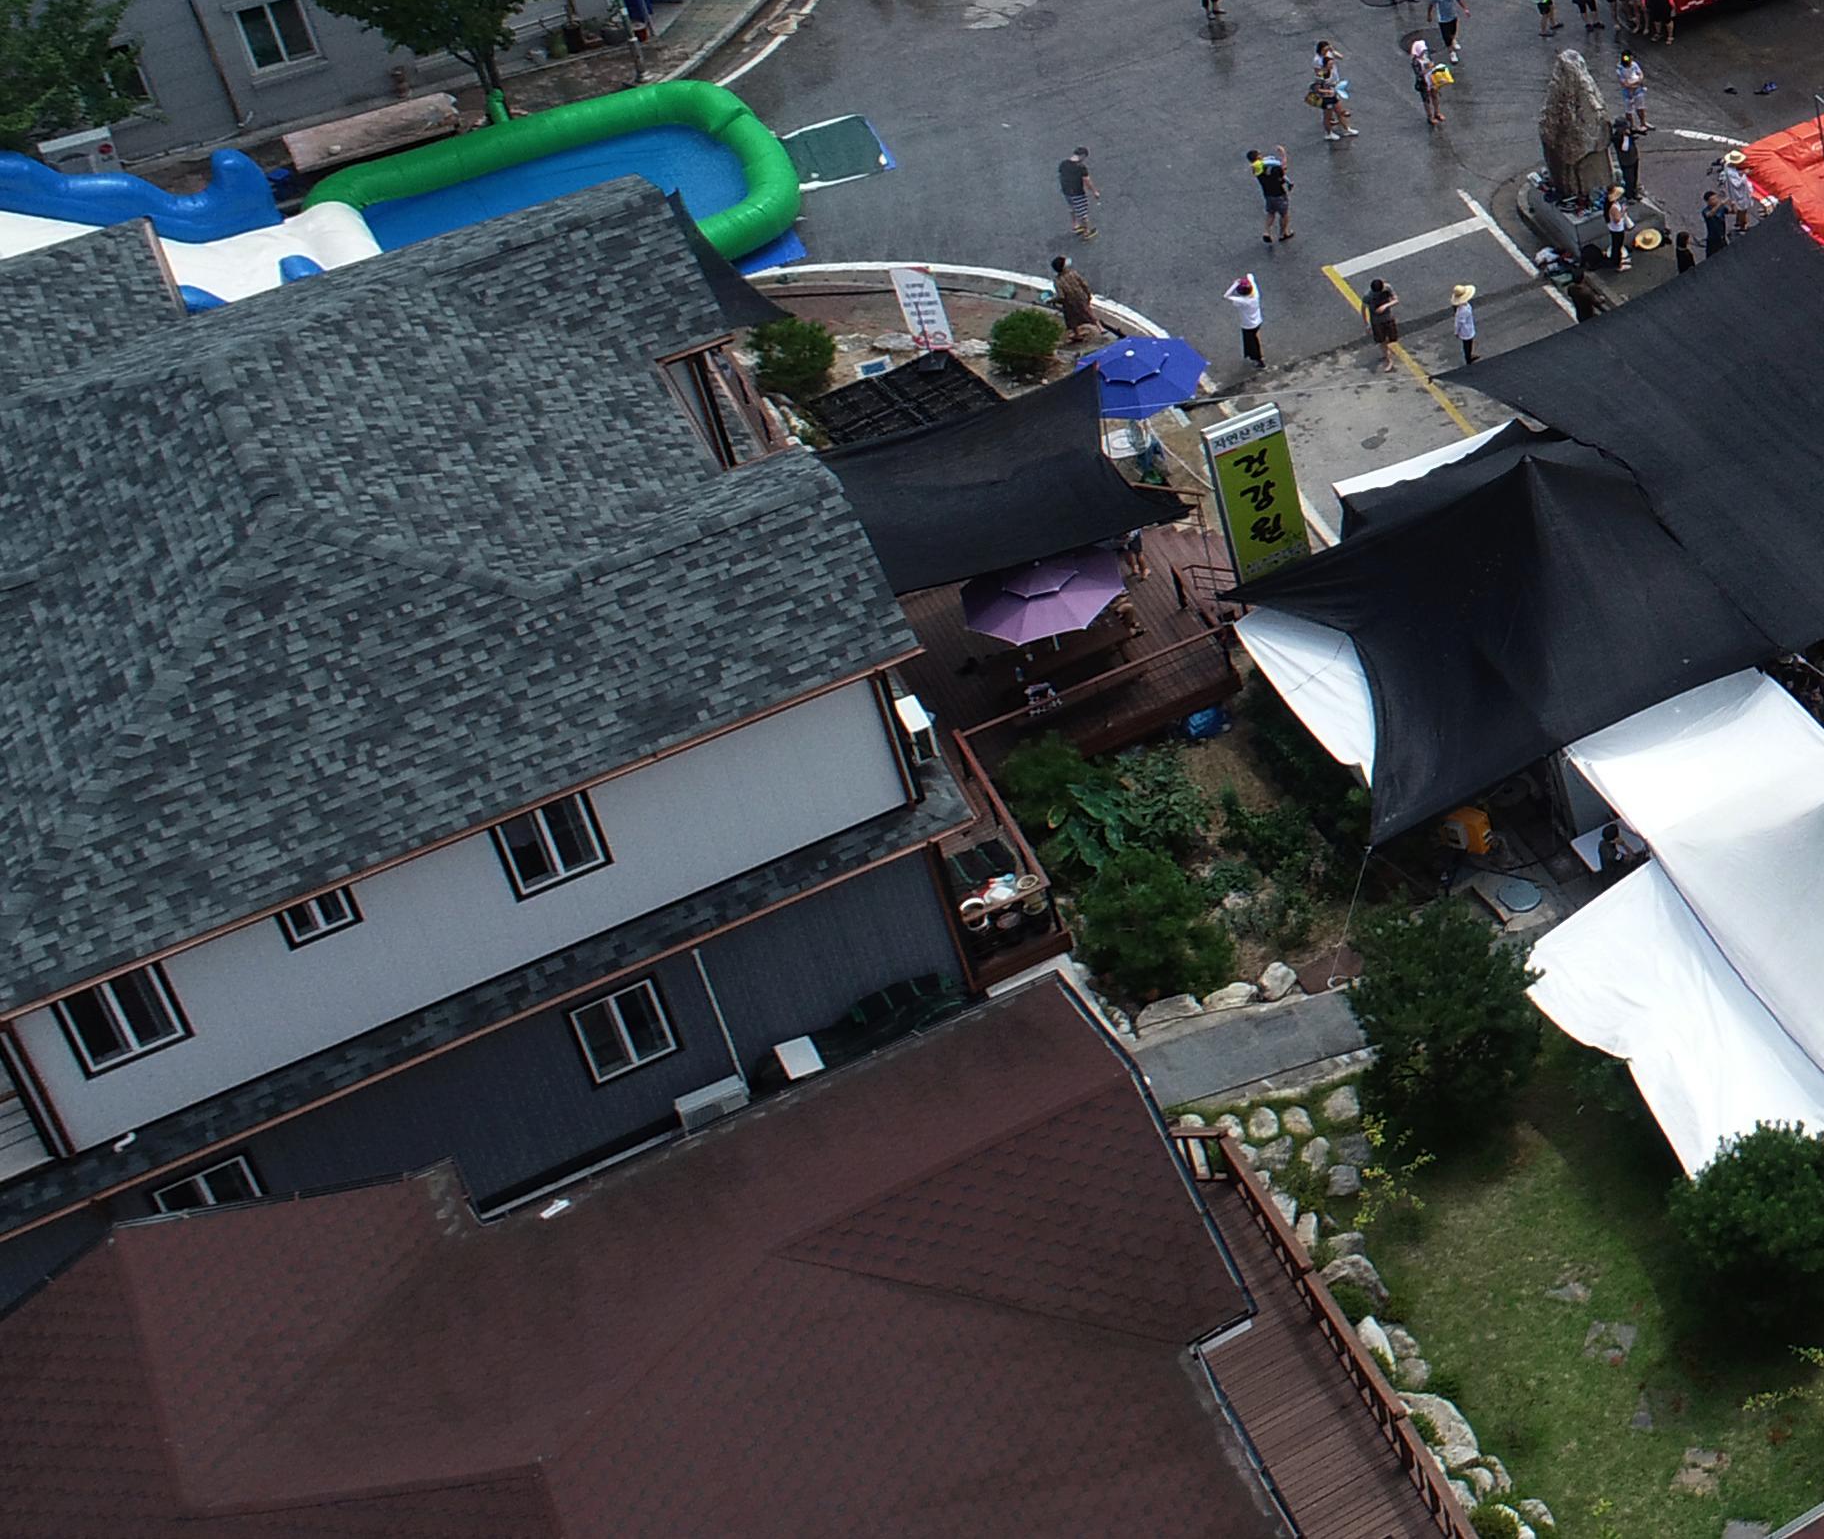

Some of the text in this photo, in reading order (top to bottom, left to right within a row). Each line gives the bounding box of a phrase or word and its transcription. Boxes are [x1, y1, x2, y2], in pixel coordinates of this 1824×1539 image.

[1213, 418, 1279, 449] 자연산 약초
[1232, 447, 1286, 544] 건강원
